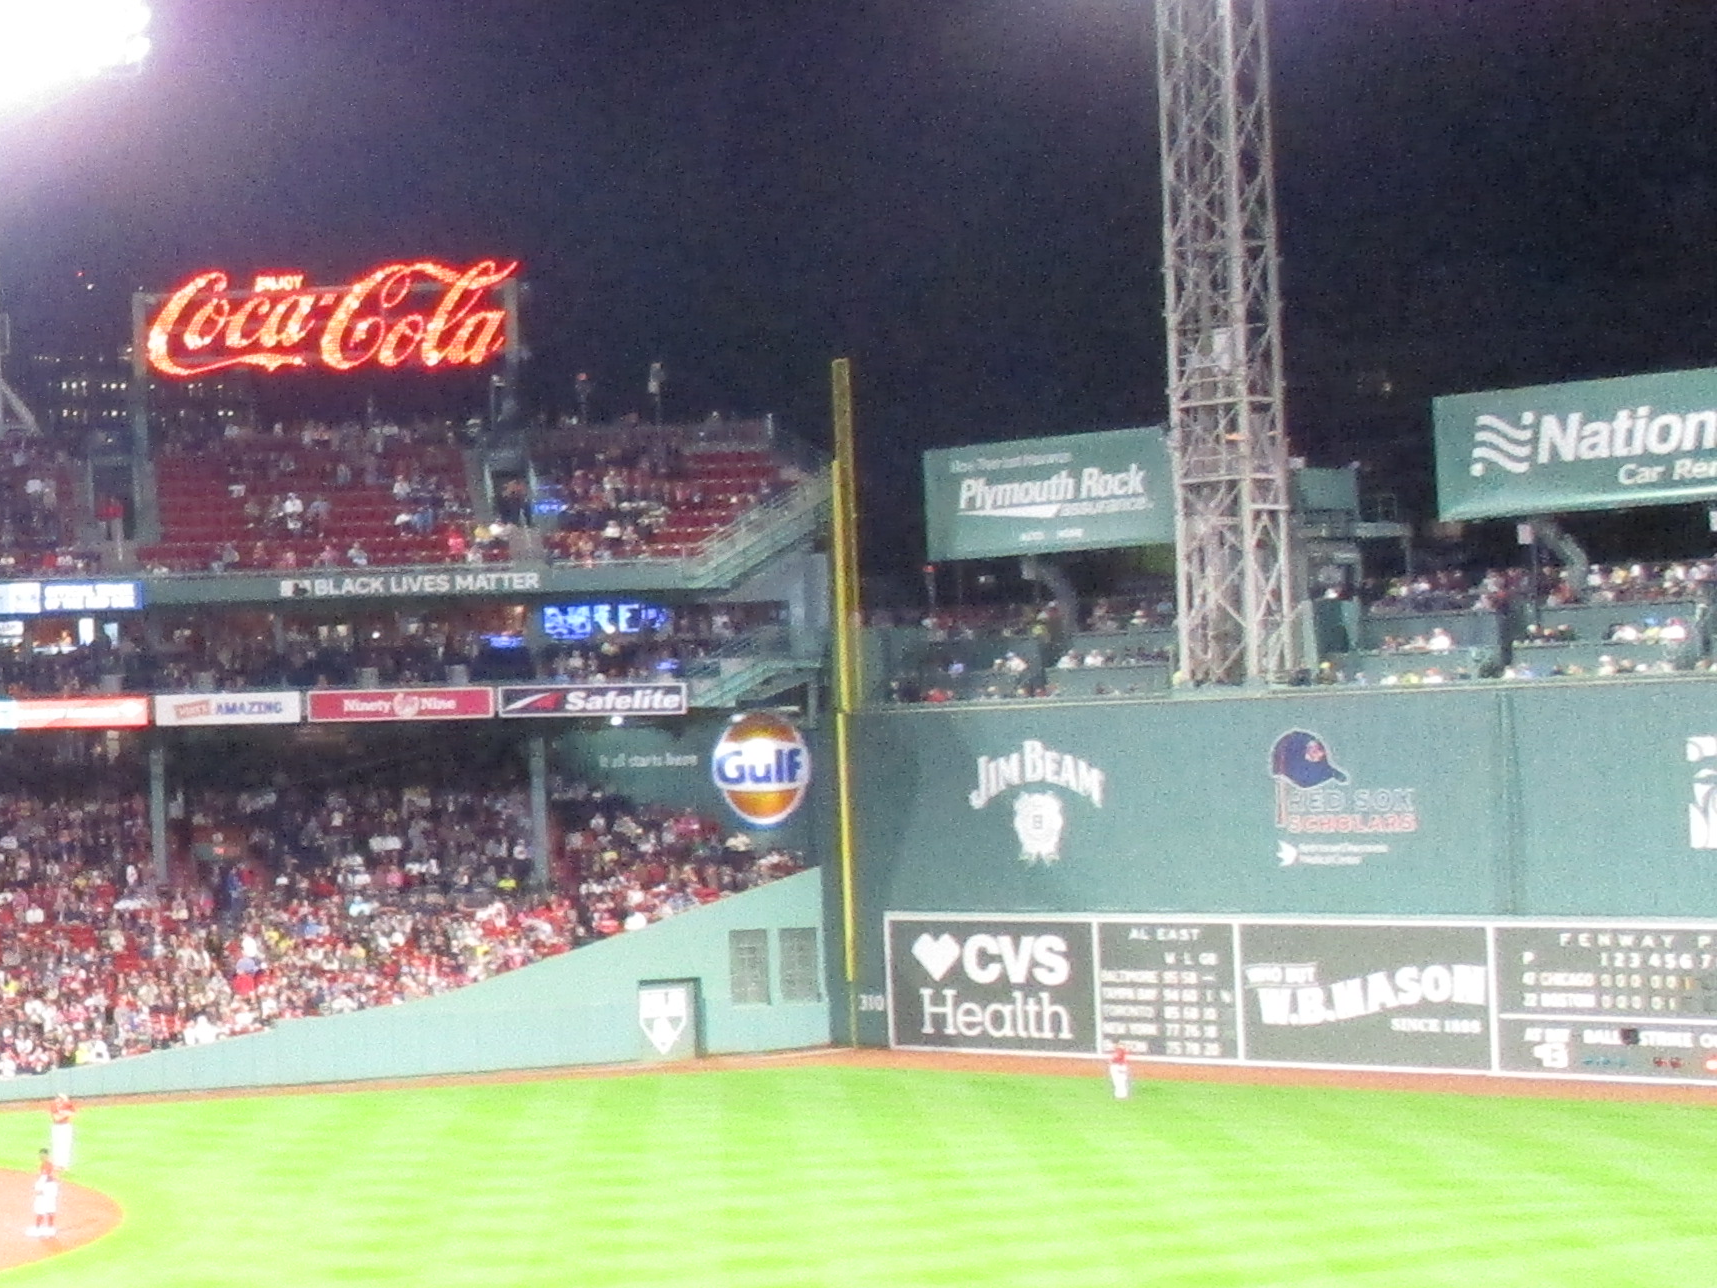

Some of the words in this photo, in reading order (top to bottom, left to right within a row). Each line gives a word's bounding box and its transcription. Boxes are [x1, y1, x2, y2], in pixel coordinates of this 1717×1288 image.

[254, 274, 304, 292] ENJOY
[147, 260, 518, 375] Coca-Cola
[1618, 464, 1665, 484] Car
[959, 469, 1075, 511] Plymouth
[1080, 463, 1147, 499] Rock
[314, 577, 383, 597] BLACK
[390, 575, 451, 594] LIVES
[455, 572, 540, 591] MATTER
[216, 701, 283, 715] AMAZING
[343, 699, 391, 713] Ninety
[421, 697, 457, 710] Nine
[565, 689, 680, 711] Safelite
[716, 748, 802, 784] Gulf
[968, 753, 1023, 809] JIM
[1022, 739, 1106, 808] BEAM
[1287, 788, 1350, 812] RED
[1358, 788, 1416, 811] SOX
[1286, 813, 1418, 833] SCHOLARS
[1128, 927, 1150, 940] AL
[1156, 927, 1200, 940] EAST
[1560, 932, 1675, 949] FENWAY
[962, 933, 1071, 985] CVS
[858, 994, 884, 1011] 310
[919, 988, 1073, 1040] Health
[1390, 1018, 1441, 1032] SINCE
[1639, 1031, 1694, 1048] STRIKE
